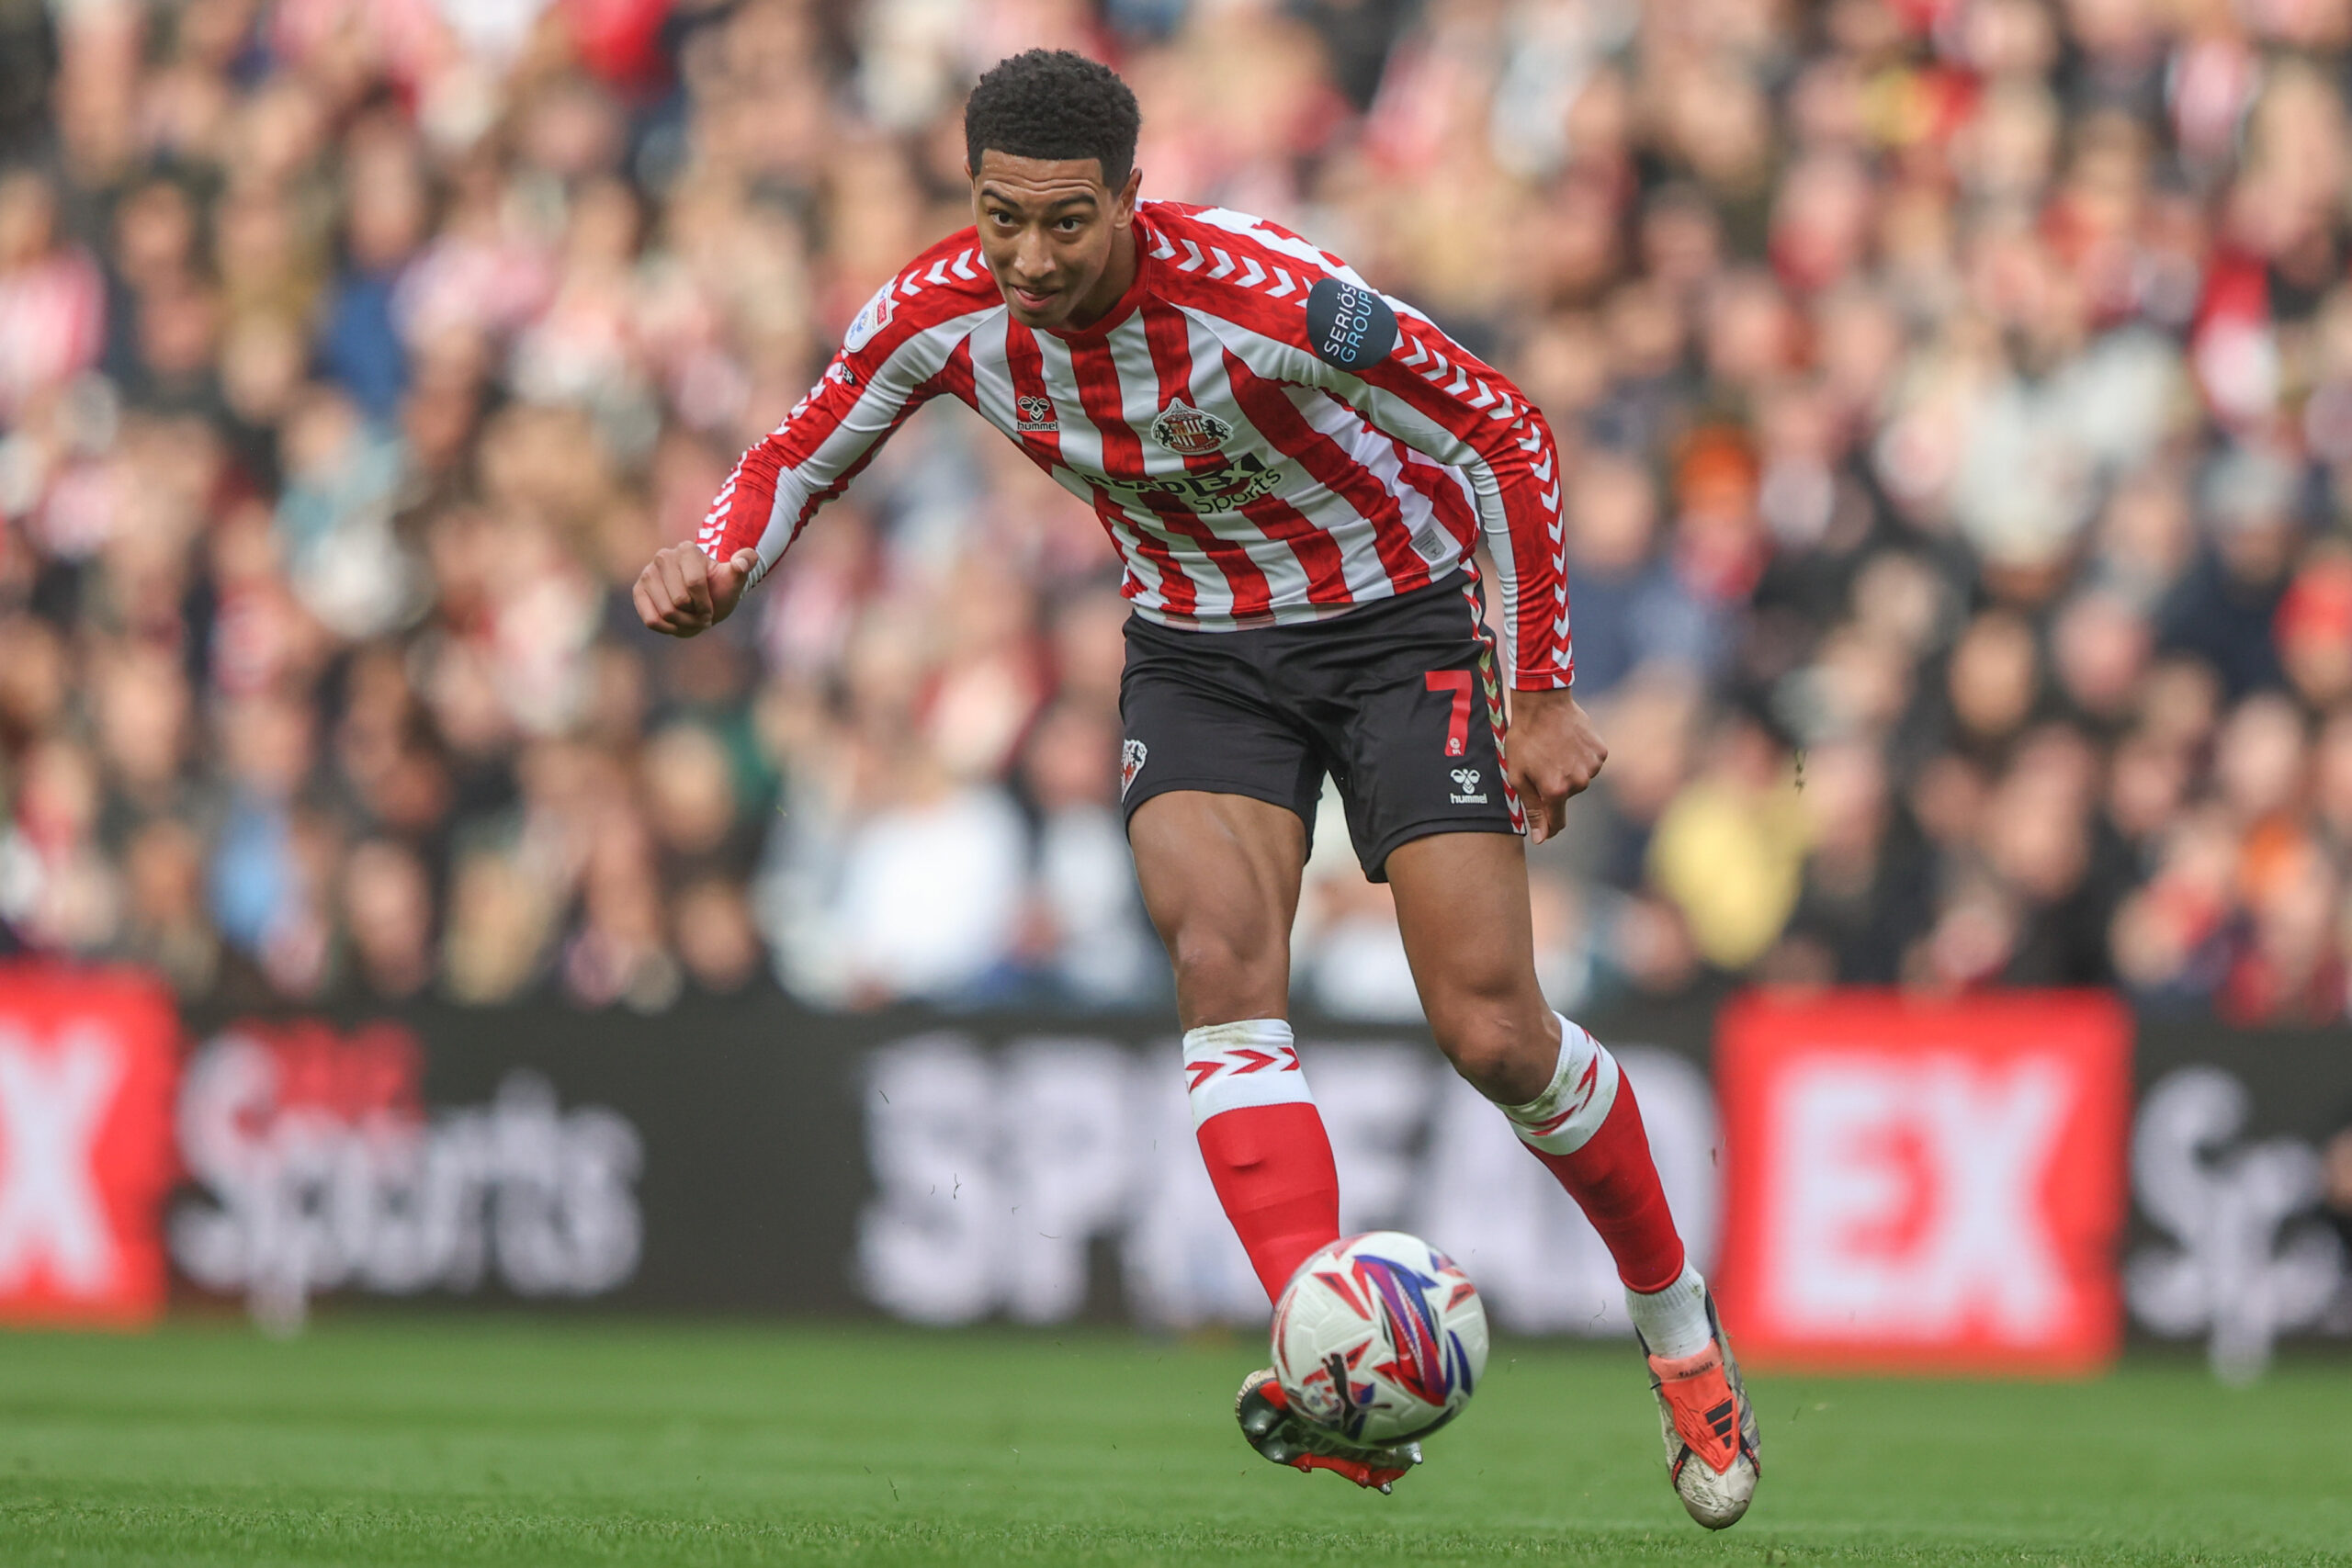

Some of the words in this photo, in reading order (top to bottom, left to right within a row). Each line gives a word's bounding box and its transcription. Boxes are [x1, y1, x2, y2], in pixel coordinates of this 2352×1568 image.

[1324, 284, 1357, 356] SERIÖS
[1340, 290, 1373, 363] GROUP
[1017, 420, 1058, 431] hummel
[1194, 468, 1282, 513] Sports
[1425, 670, 1473, 756] 7
[1450, 793, 1487, 804] hummel
[168, 1032, 645, 1339] Sports
